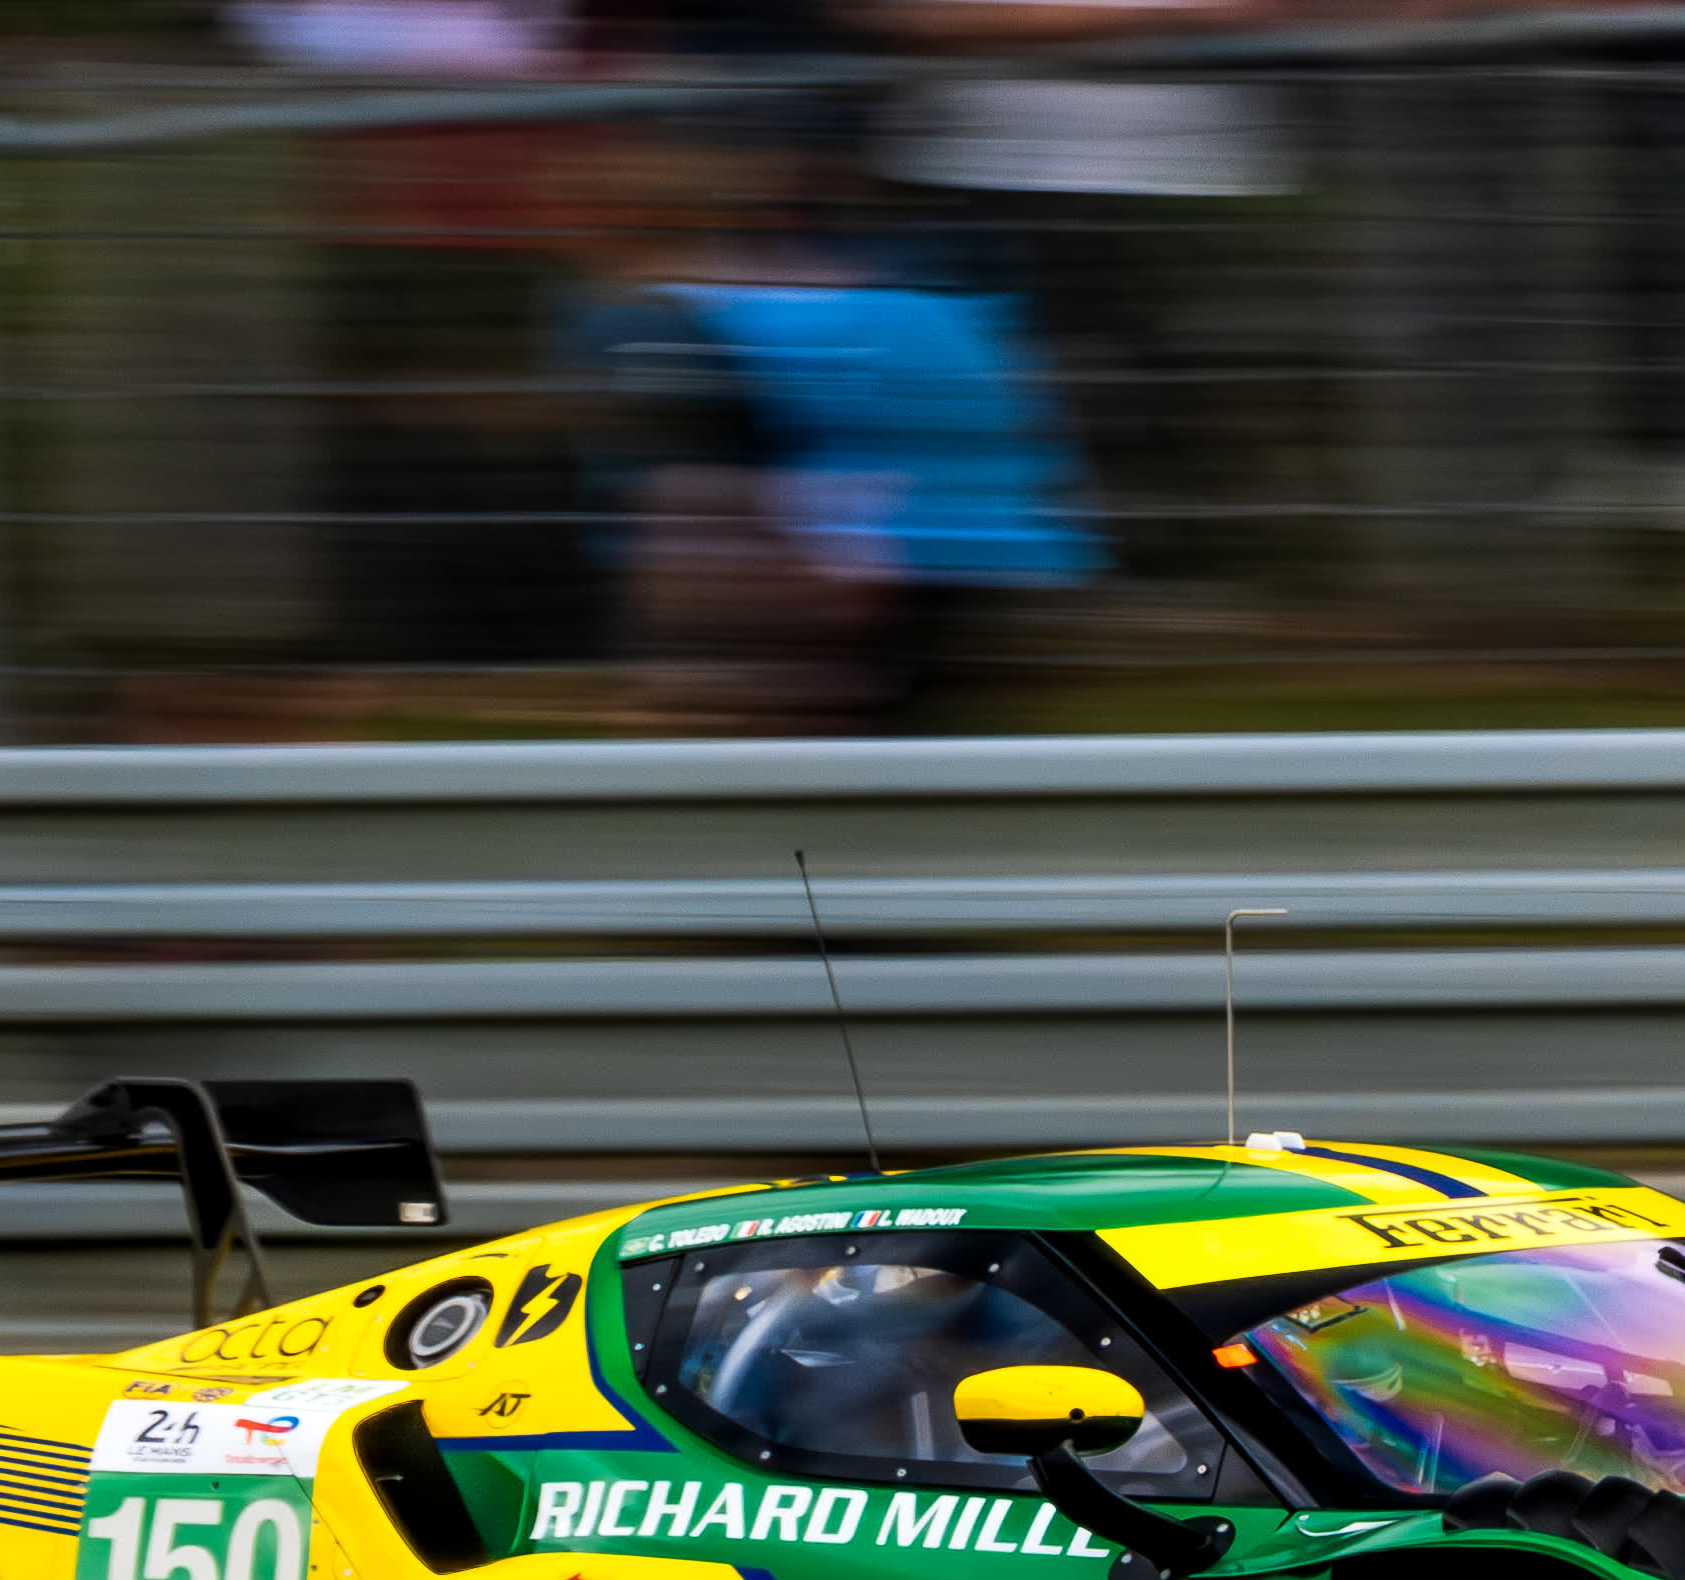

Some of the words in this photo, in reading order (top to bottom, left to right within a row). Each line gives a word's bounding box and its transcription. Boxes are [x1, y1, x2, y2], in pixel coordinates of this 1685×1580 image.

[668, 1223, 730, 1249] TOLEDO
[1337, 1194, 1669, 1249] Ferrari
[530, 1480, 870, 1545] RICHARD
